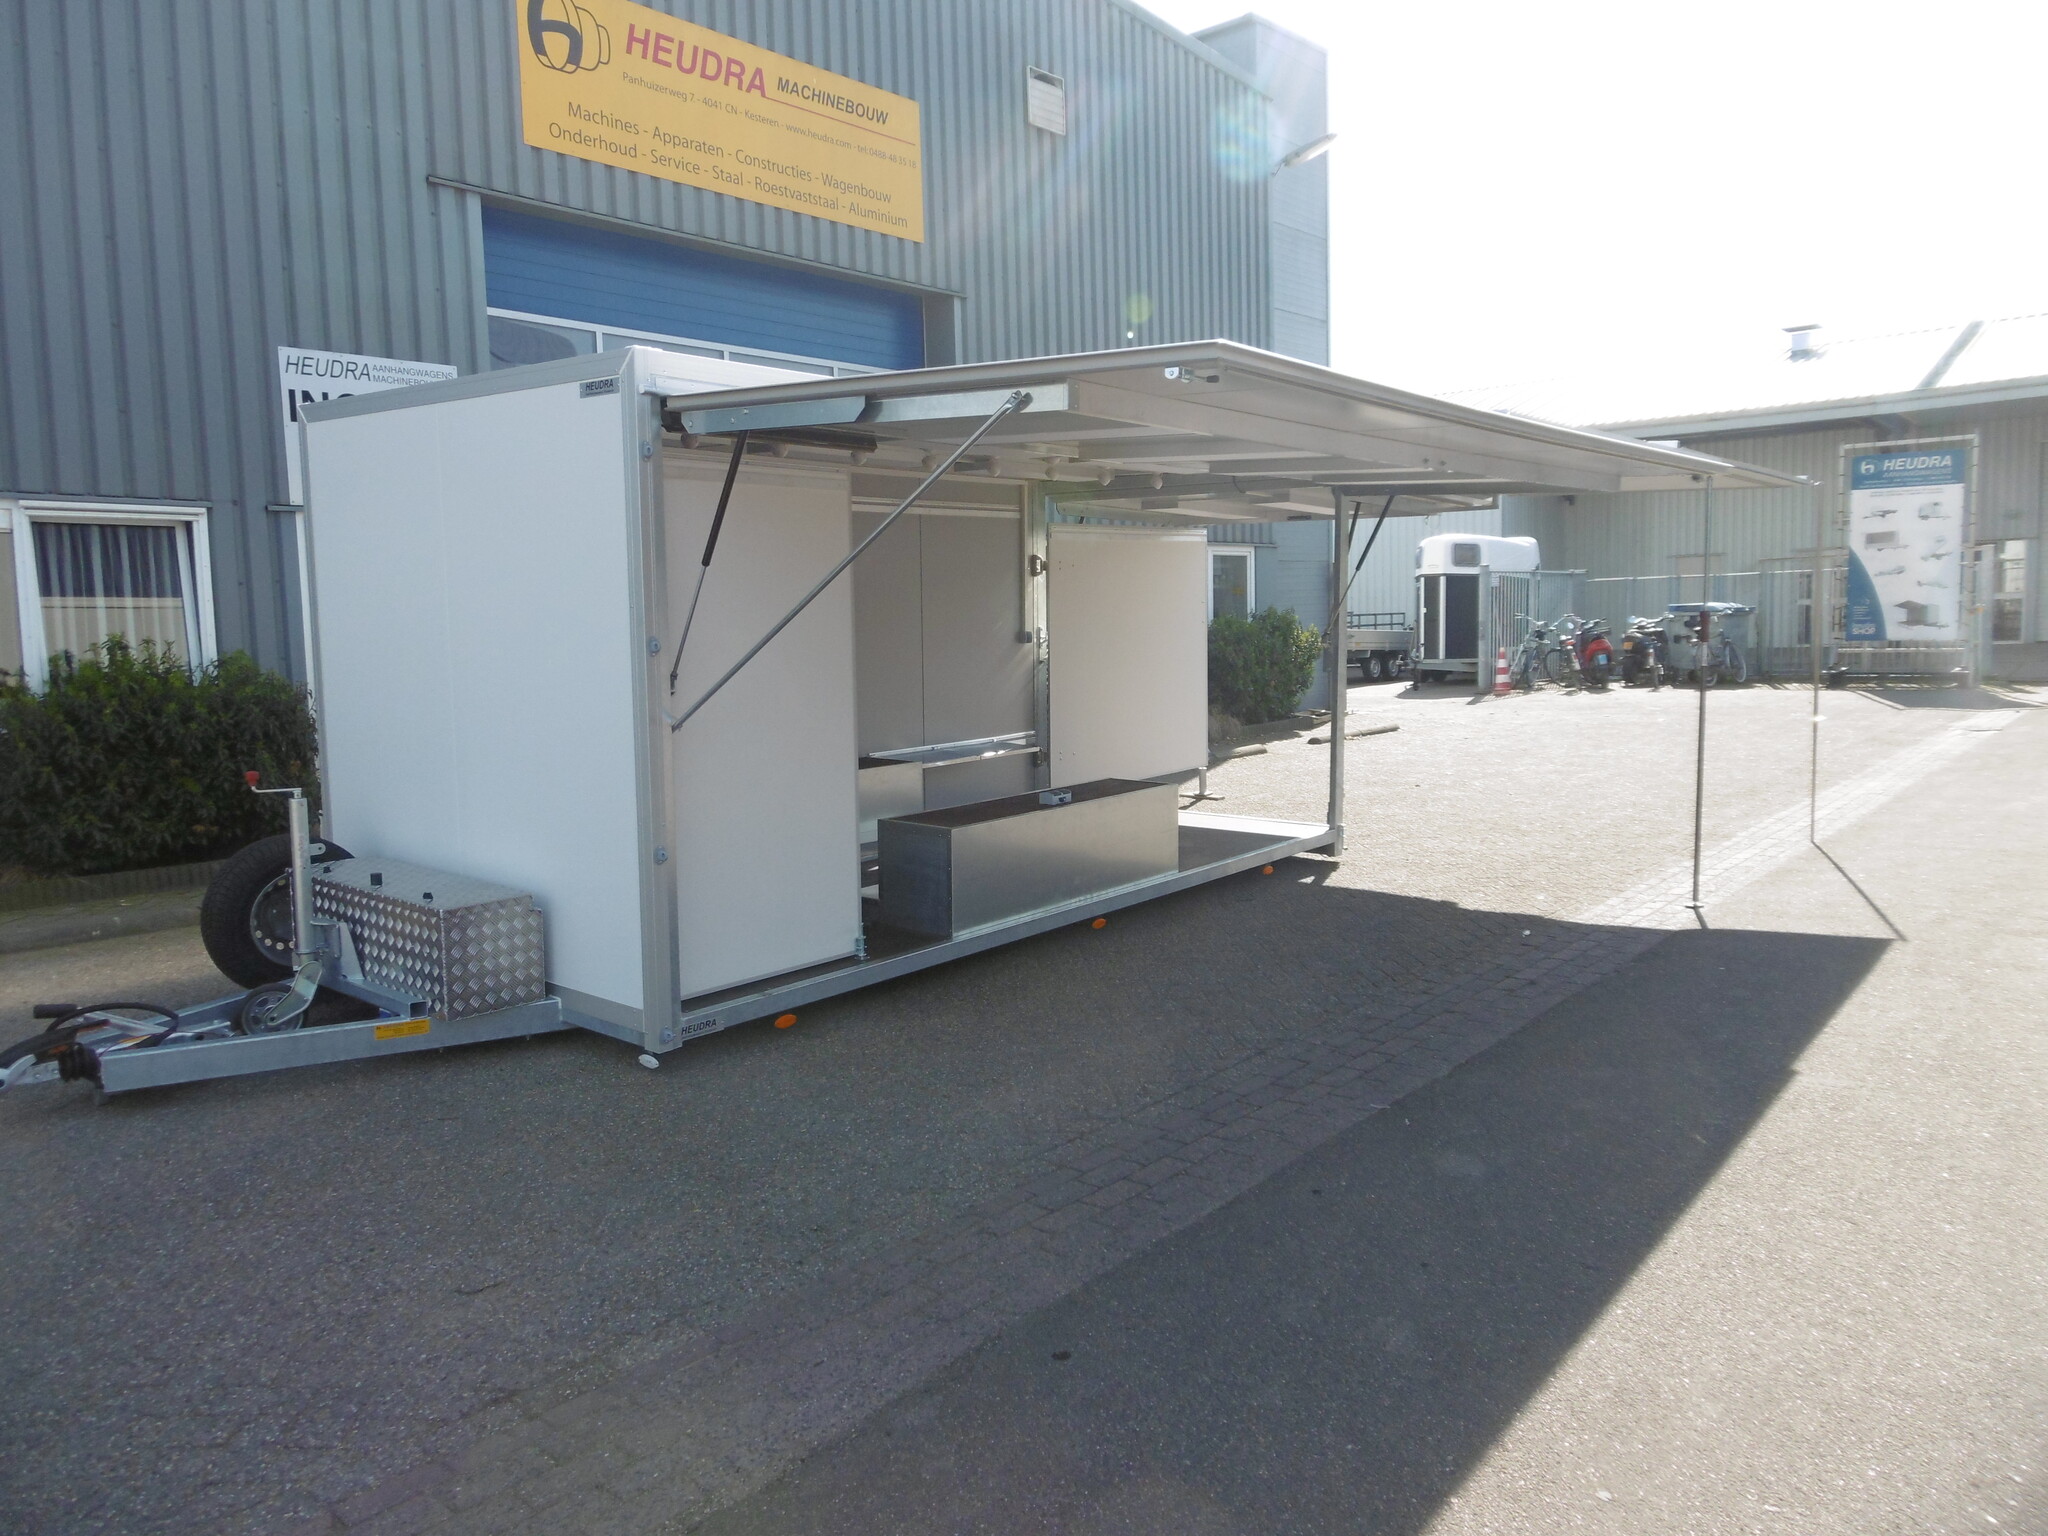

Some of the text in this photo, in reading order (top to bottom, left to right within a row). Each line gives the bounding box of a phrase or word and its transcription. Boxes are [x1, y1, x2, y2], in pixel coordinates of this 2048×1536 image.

[626, 23, 889, 125] HEUDRA MACHINEBOUW
[622, 71, 688, 103] Panhuizerweg
[702, 97, 722, 110] 4041
[725, 103, 738, 115] CN
[745, 108, 780, 128] Kesteren
[785, 123, 852, 150] www.heudra.com
[568, 101, 640, 135] Machines
[652, 126, 724, 158] Apparaten
[735, 149, 812, 182] Constructies
[821, 172, 892, 204] Wagenbouw
[549, 122, 638, 159] Onderhoud
[650, 149, 700, 175] Service
[712, 165, 743, 186] Staal
[755, 176, 839, 211] Roestvaststaal
[849, 201, 908, 229] Aluminium
[285, 355, 371, 381] HEUDRA
[372, 364, 454, 379] AANHANGWAGENS
[585, 379, 614, 391] HEUDRA
[1883, 455, 1952, 471] HEUDRA
[681, 1019, 717, 1036] HEUDRA
